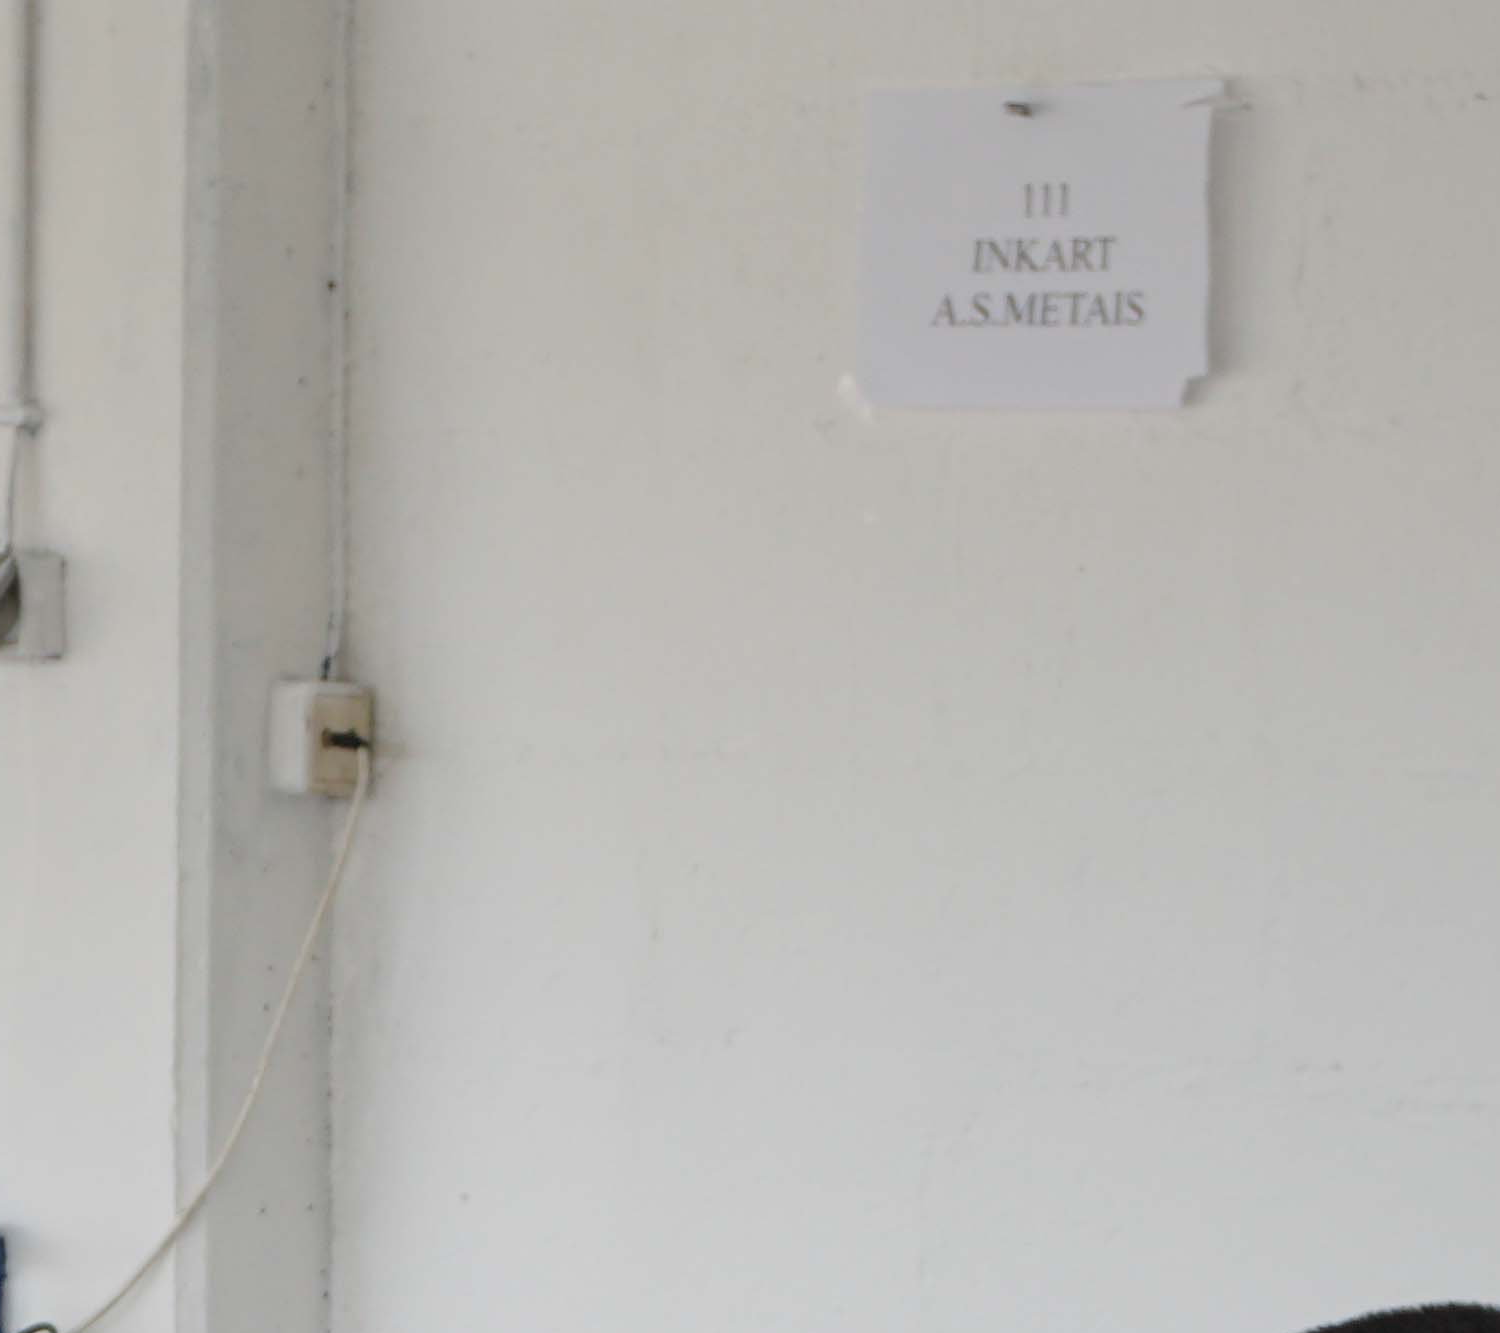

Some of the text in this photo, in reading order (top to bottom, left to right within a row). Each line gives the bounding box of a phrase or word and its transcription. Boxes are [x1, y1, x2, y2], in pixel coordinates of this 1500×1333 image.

[1023, 181, 1072, 219] 111
[971, 235, 1117, 273] INKART
[929, 291, 1147, 328] A.S.METAIS
